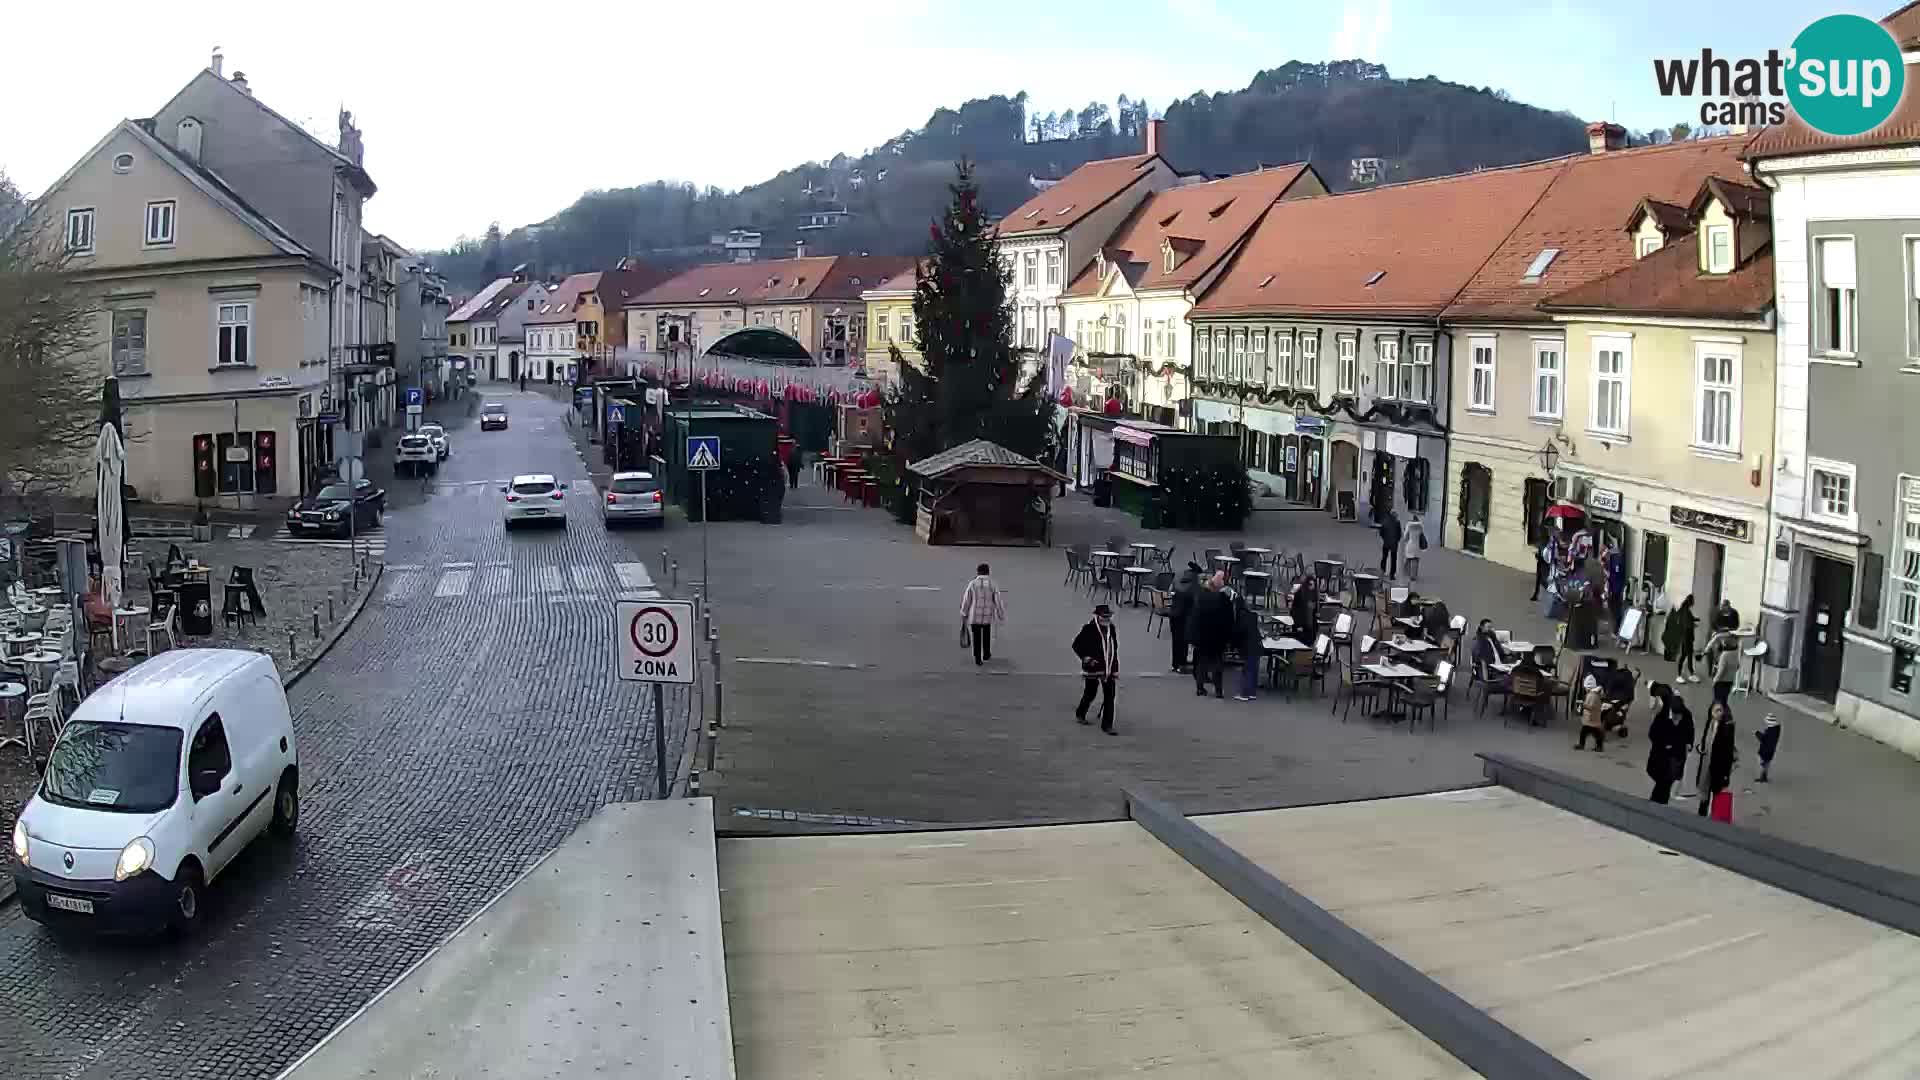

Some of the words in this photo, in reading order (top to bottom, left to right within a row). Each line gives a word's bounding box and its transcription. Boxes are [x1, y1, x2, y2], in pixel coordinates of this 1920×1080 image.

[411, 391, 418, 402] P
[643, 623, 667, 643] 30
[634, 660, 678, 676] ZONA
